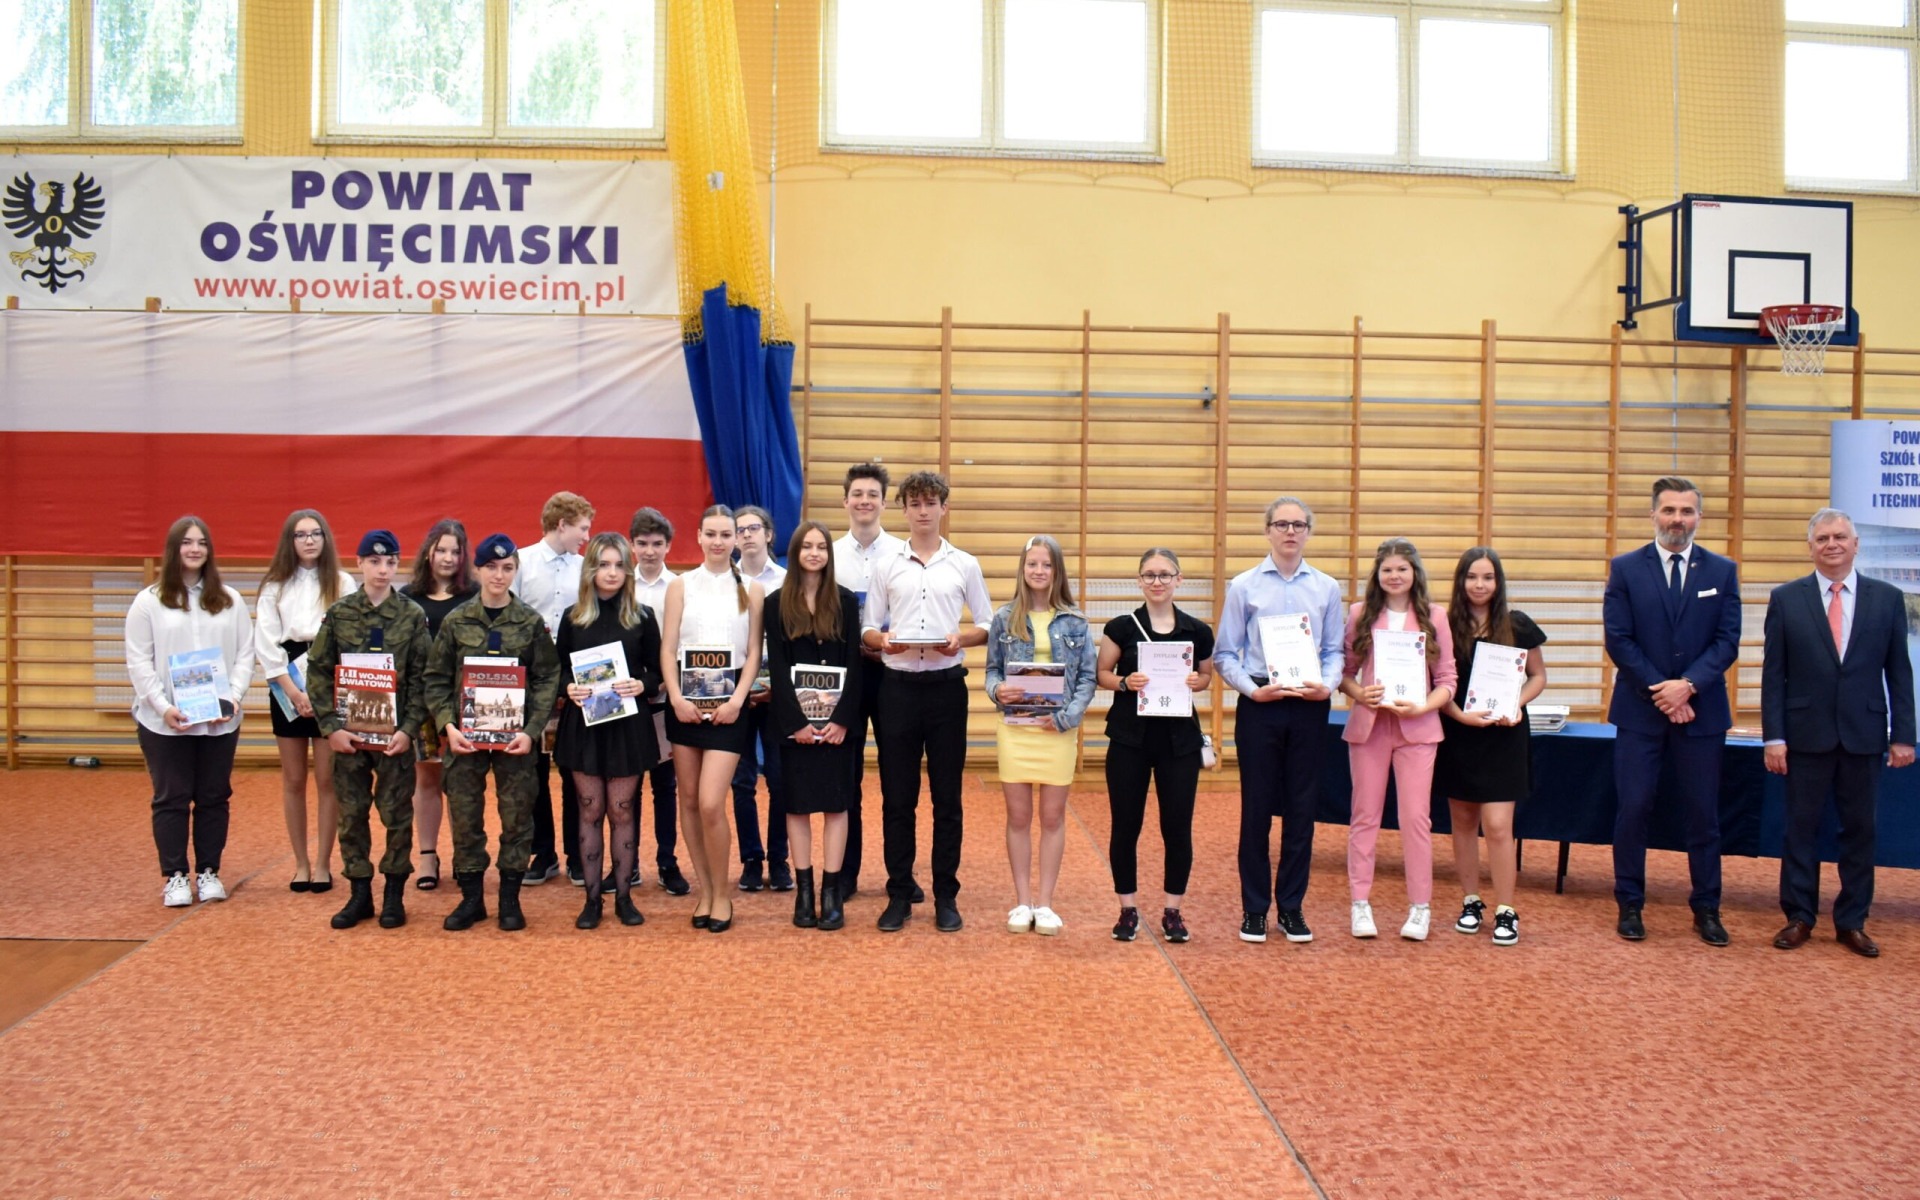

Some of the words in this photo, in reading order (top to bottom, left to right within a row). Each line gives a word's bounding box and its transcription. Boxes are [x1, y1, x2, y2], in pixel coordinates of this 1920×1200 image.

[291, 170, 532, 211] POWIAT
[200, 210, 619, 272] OŚWIĘCIMSKI
[194, 273, 625, 307] www.powiat.oswiecim.pl
[1880, 449, 1915, 466] SZKÓŁ
[1881, 472, 1920, 487] MISTR
[1872, 493, 1877, 508] I
[690, 652, 726, 667] 1000
[339, 676, 393, 689] ŚWIATOWA
[358, 672, 393, 682] WOJNA
[468, 672, 518, 681] POLSKA
[800, 673, 835, 688] 1000
